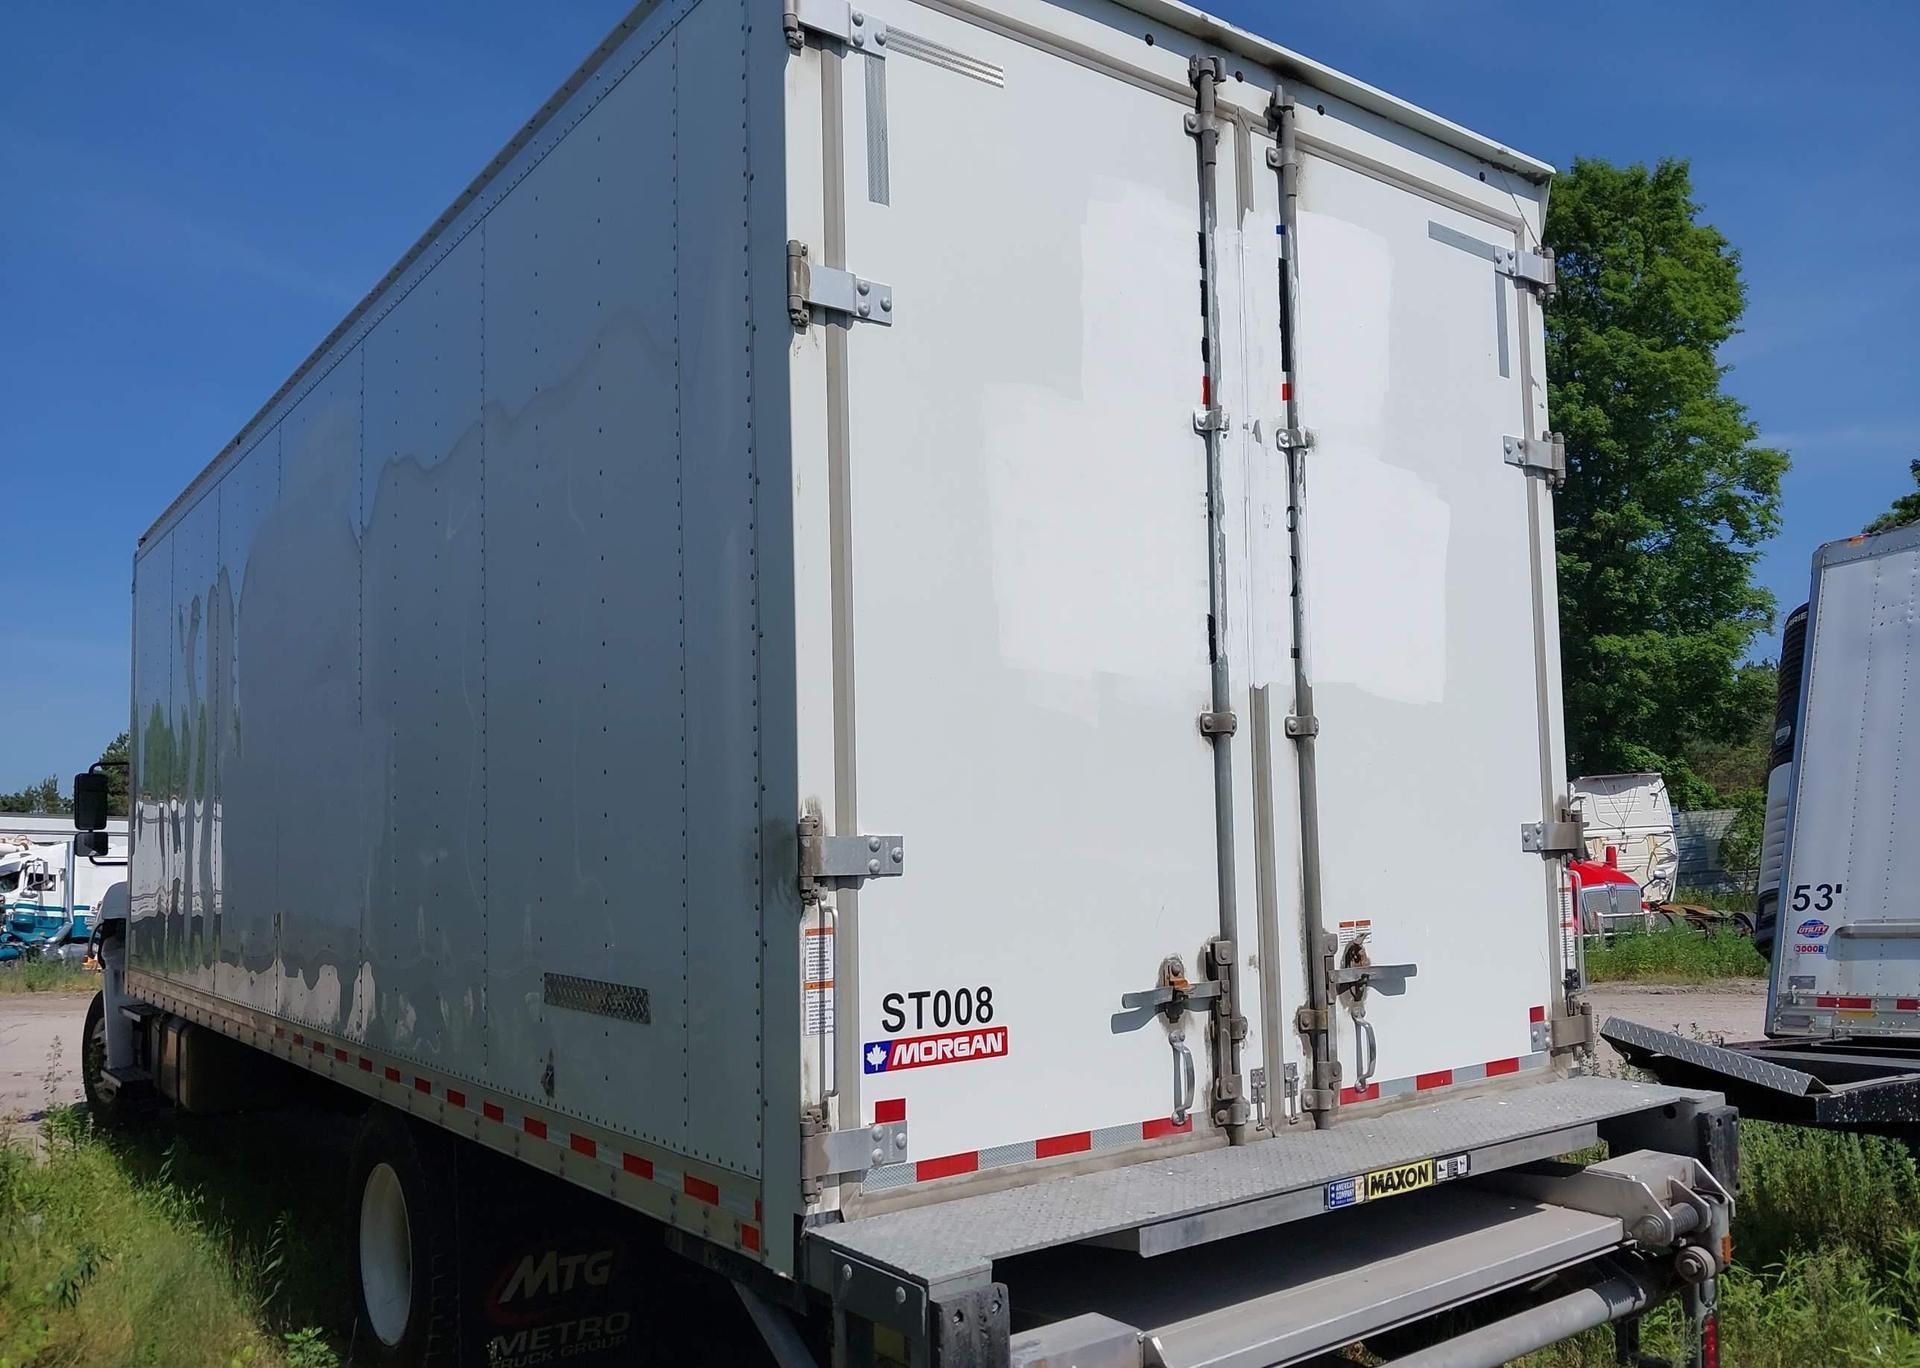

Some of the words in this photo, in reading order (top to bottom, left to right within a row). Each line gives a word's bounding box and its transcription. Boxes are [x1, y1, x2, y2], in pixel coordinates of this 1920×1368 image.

[1792, 884, 1842, 911] 53'
[1798, 925, 1828, 934] UTILITY
[1795, 945, 1824, 953] 3000R
[882, 986, 994, 1033] ST008
[892, 1032, 1003, 1066] MORGAN
[1370, 1162, 1429, 1196] MAXON
[498, 1250, 614, 1304] MTG
[488, 1347, 555, 1368] TRUCK
[560, 1334, 628, 1358] GROUP
[491, 1312, 631, 1356] METRO
